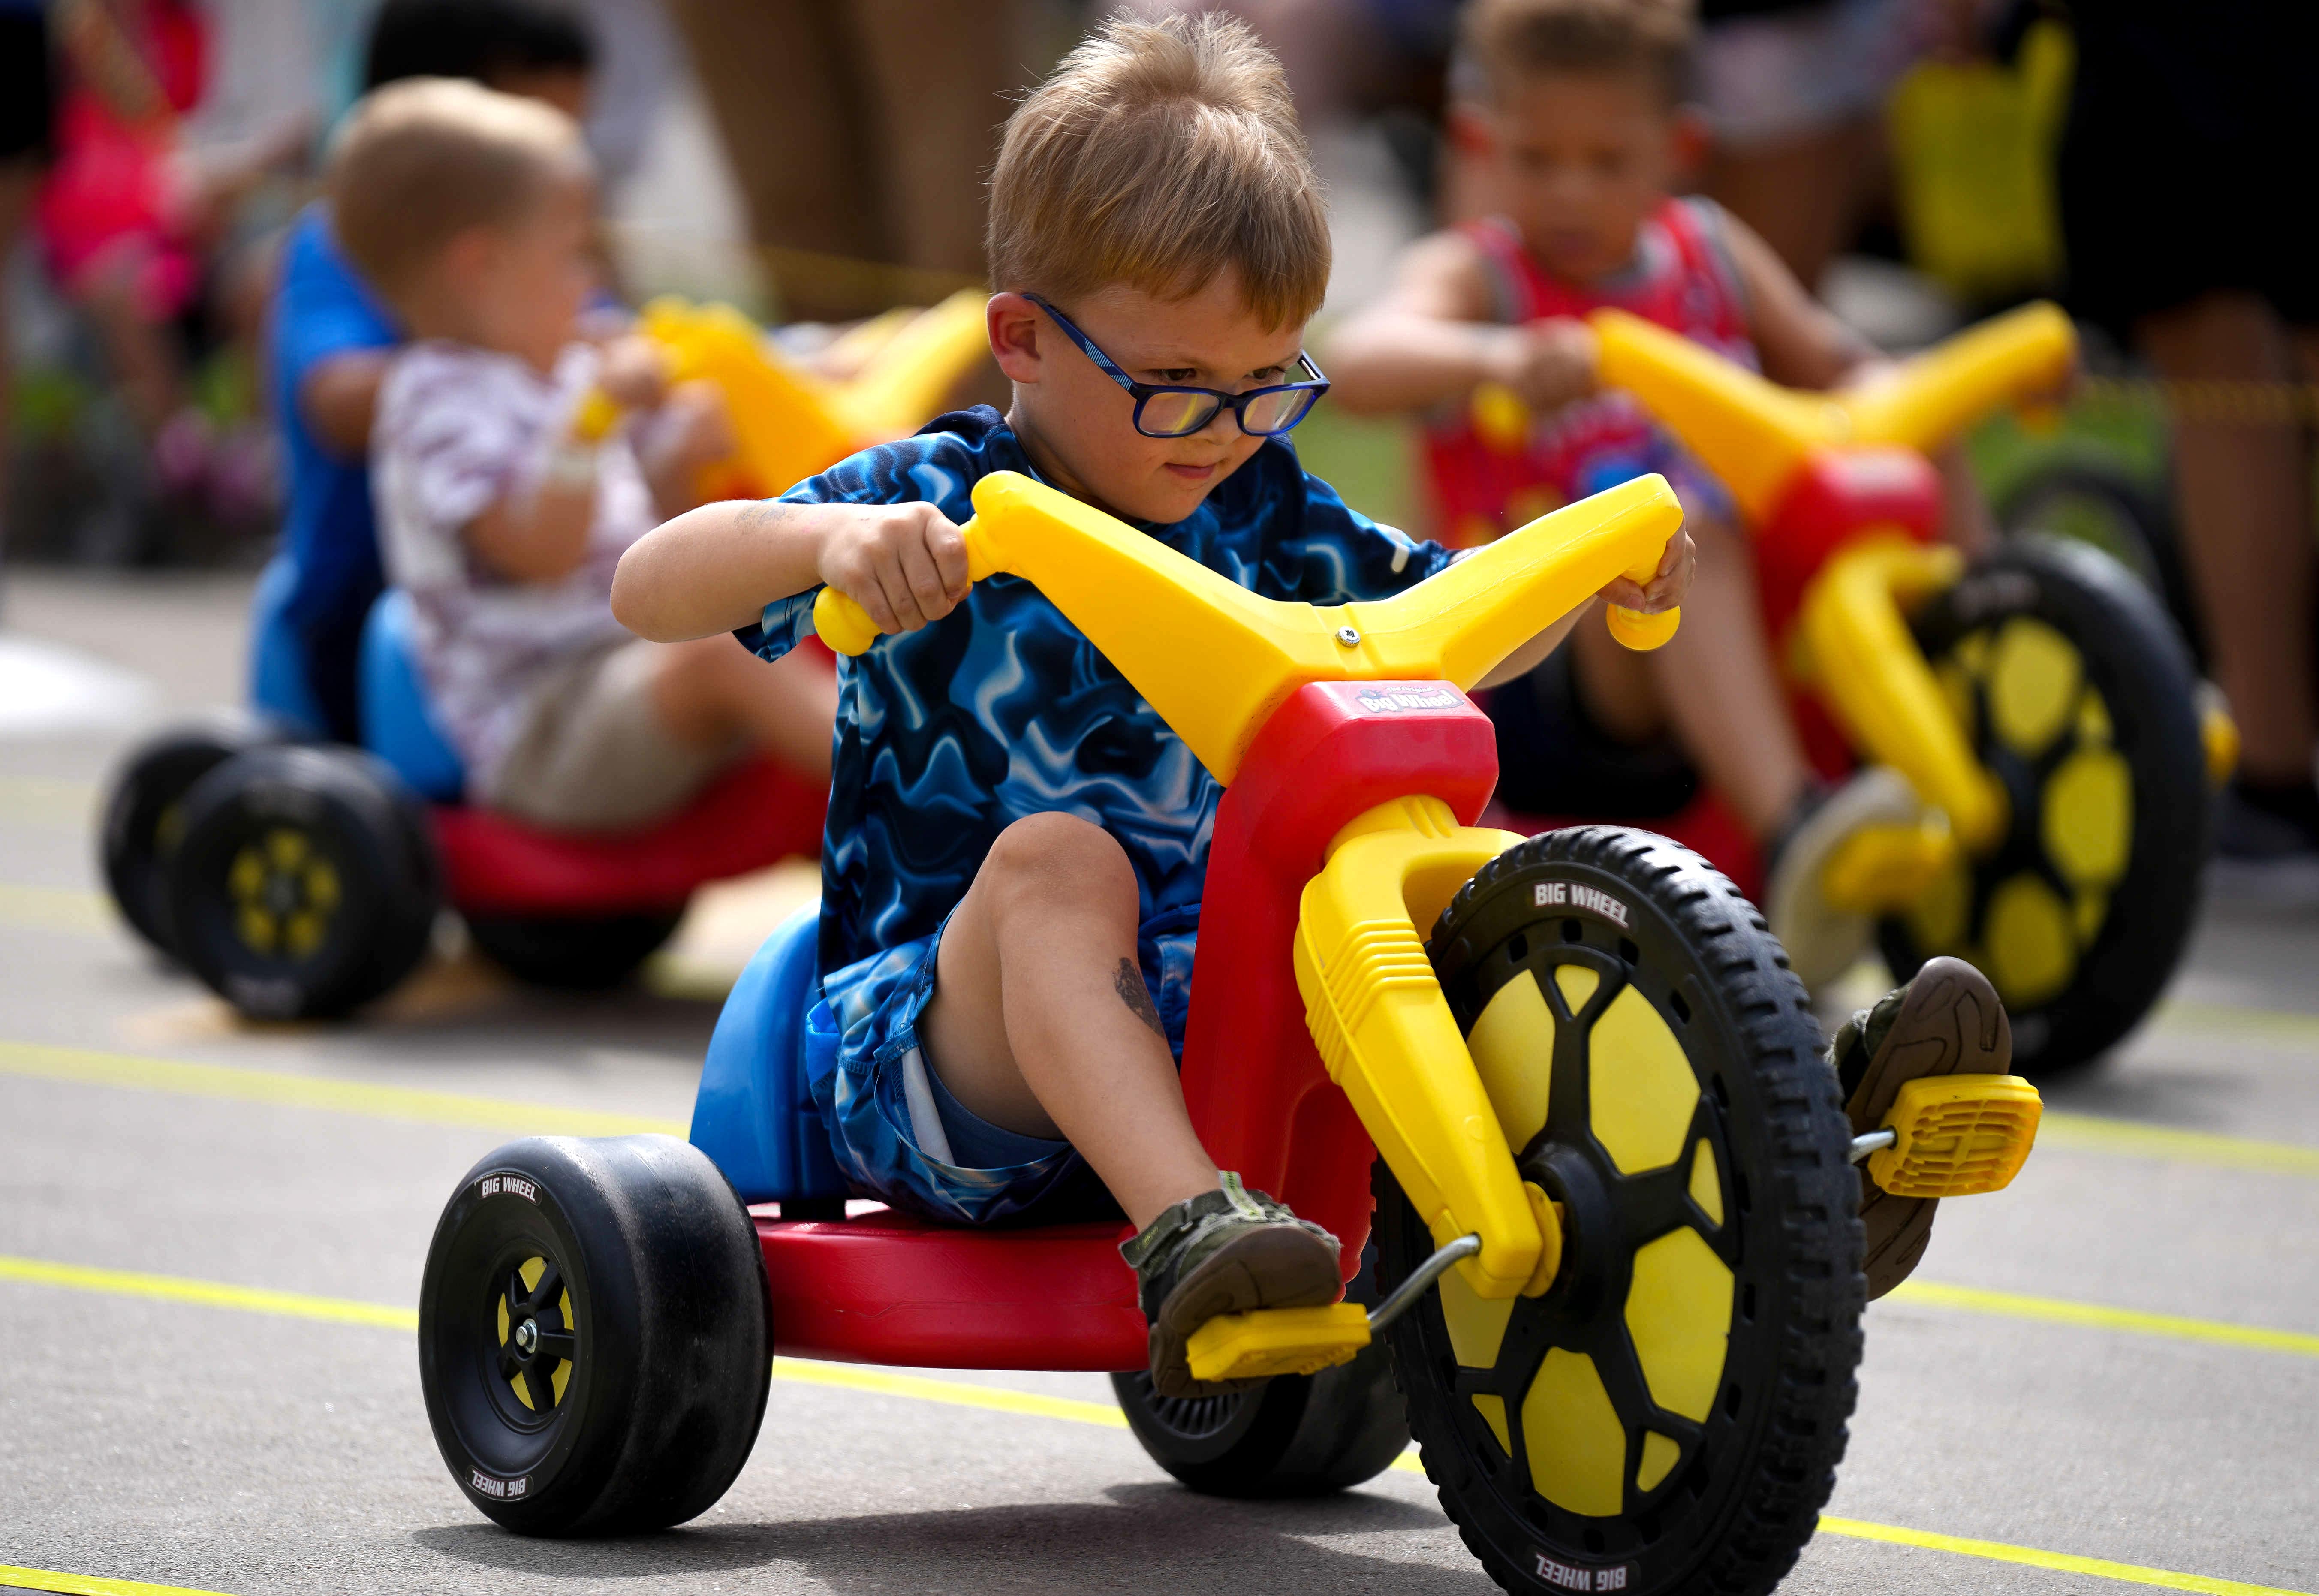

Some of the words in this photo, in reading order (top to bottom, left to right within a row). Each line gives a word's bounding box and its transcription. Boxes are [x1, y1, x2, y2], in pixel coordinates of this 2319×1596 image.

[1358, 696, 1399, 712] Big
[1390, 690, 1460, 708] Wheel
[1535, 883, 1566, 906] BIG
[1570, 883, 1629, 929] WHEEL
[482, 1177, 500, 1198] BIG
[503, 1177, 536, 1203] WHEEL
[472, 1469, 505, 1497] WHEEL
[507, 1478, 526, 1497] BIG
[1536, 1552, 1591, 1591] WHEEL
[1596, 1566, 1627, 1592] BIG
